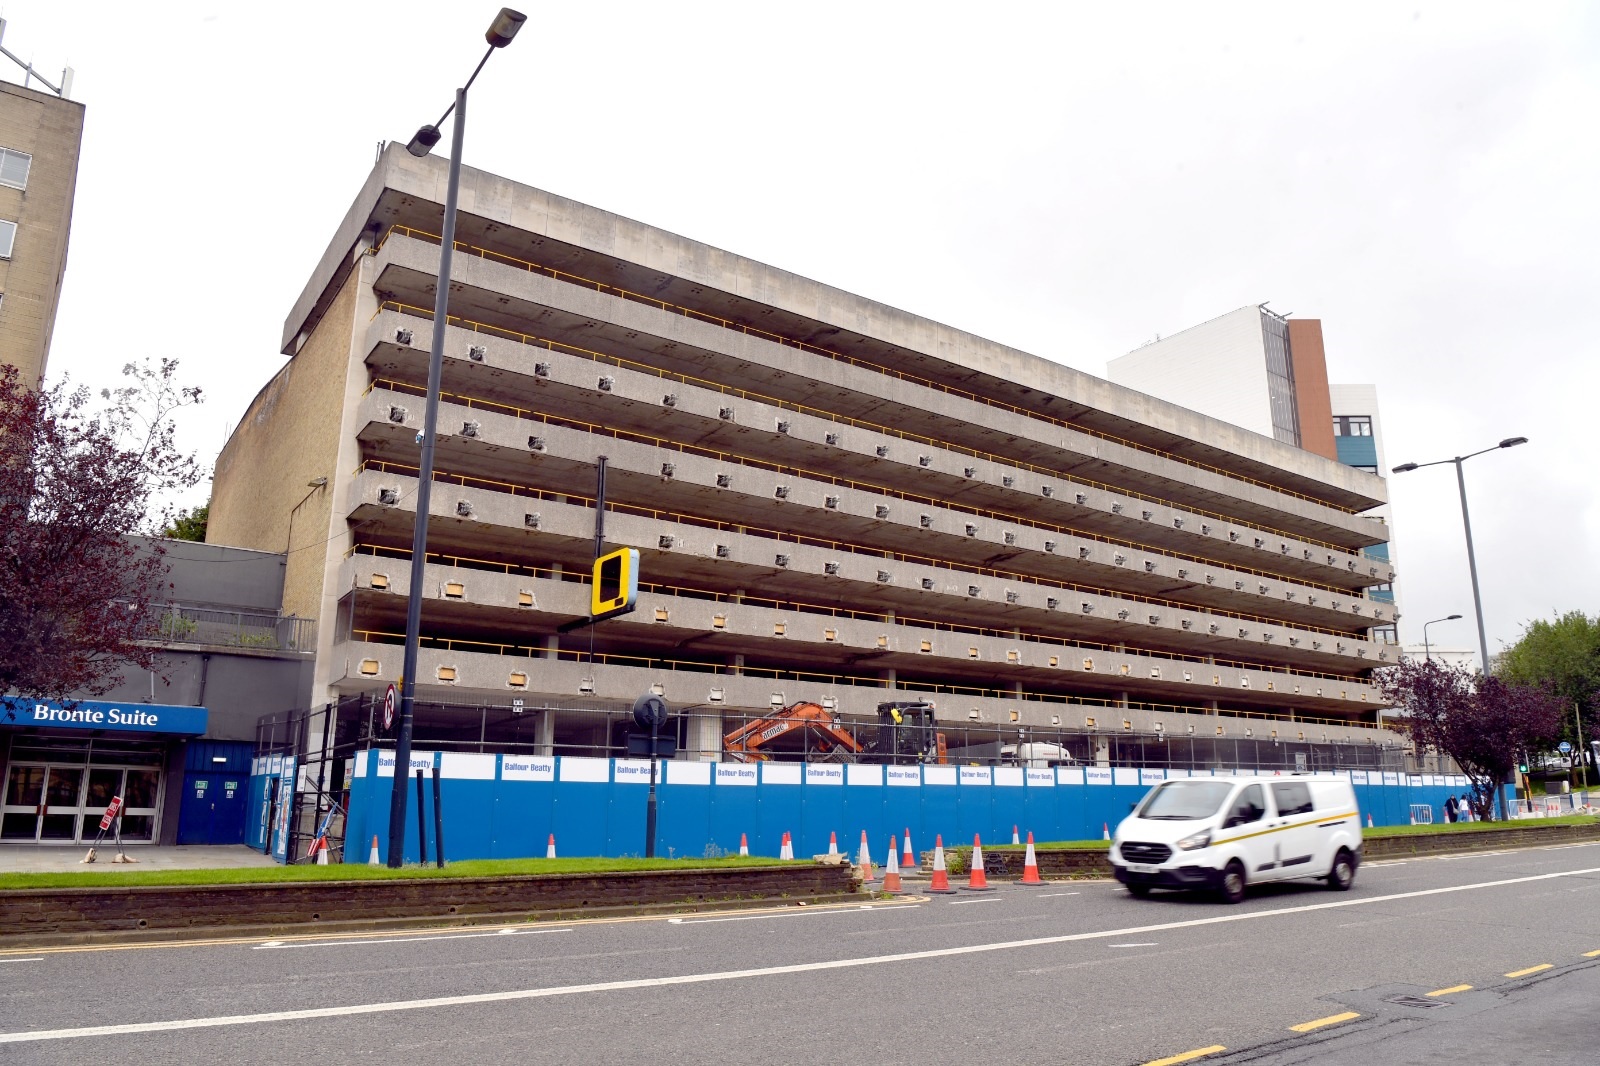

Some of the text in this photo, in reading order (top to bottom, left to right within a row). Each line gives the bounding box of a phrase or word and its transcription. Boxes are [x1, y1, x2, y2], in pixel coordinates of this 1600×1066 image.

[34, 704, 158, 726] Bronte Suite
[505, 762, 552, 773] Balfour Beatty
[617, 766, 659, 776] Balfour Beay
[717, 769, 756, 778] Balfour Beatty
[807, 769, 841, 778] Balfour Beatty
